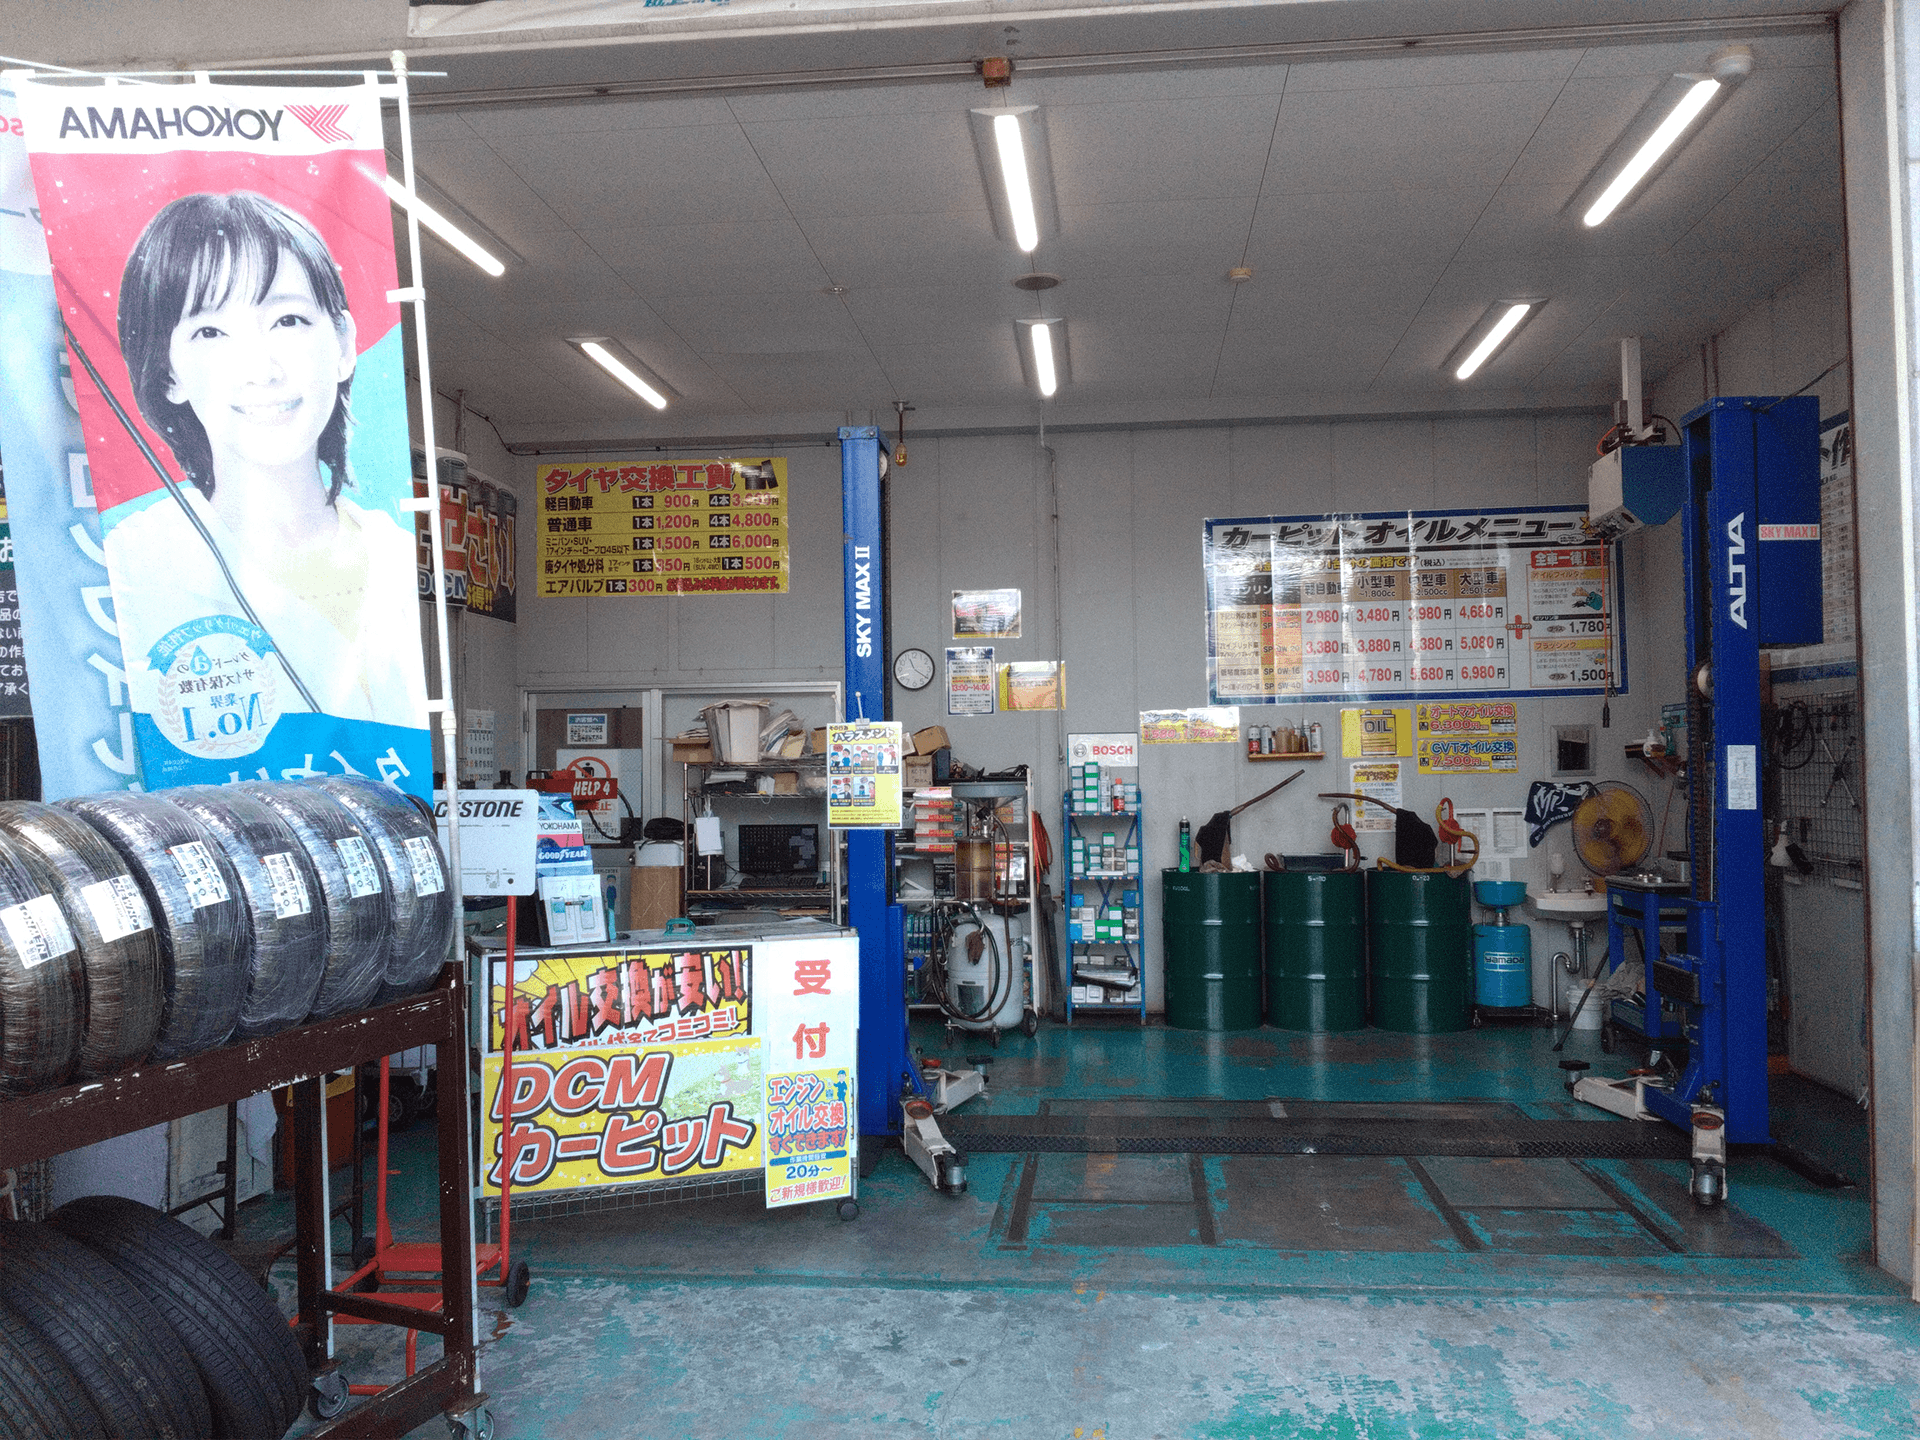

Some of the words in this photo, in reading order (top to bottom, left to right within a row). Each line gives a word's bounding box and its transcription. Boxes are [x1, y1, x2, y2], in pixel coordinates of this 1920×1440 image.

[545, 496, 593, 511] 軽自動車
[634, 497, 653, 508] 1本
[664, 494, 699, 508] 900円
[710, 495, 729, 506] 4本
[548, 517, 592, 532] 普通車
[634, 517, 653, 528] 1本
[656, 515, 699, 529] 1,200円
[710, 515, 729, 526] 4本
[732, 513, 779, 527] 4,800円
[1222, 523, 1356, 549] カーピット
[1363, 517, 1576, 545] オイルメニュー
[1761, 526, 1783, 538] SKY
[1784, 526, 1809, 538] MAX
[634, 538, 653, 549] 1本
[656, 536, 699, 550] 1,500円
[710, 535, 729, 546] 4本
[732, 534, 779, 548] 6,000円
[634, 559, 653, 571] 1本
[722, 557, 742, 569] 1本
[745, 556, 780, 569] 500円
[1728, 512, 1748, 630] ALTIA
[545, 579, 604, 594] エアバルブ
[607, 580, 626, 592] 1本
[629, 579, 663, 593] 300円
[855, 563, 870, 609] MAX
[1358, 575, 1396, 588] 小型車
[1459, 571, 1499, 586] 大型車
[1306, 609, 1348, 623] 2,980円
[1356, 608, 1400, 622] 3,480円
[1459, 605, 1503, 619] 4,680円
[857, 614, 871, 657] SKY
[1306, 640, 1348, 654] 3,380円
[1357, 639, 1401, 653] 3,880円
[1461, 636, 1504, 650] 5,080円
[1264, 667, 1274, 675] SP
[1306, 670, 1349, 684] 3,980円
[1358, 668, 1401, 682] 4,780円
[1410, 667, 1453, 681] 5,680円
[1461, 665, 1505, 680] 6,980円
[1264, 682, 1274, 690] SP
[1431, 704, 1515, 718] オートマオイル交換
[1364, 719, 1393, 733] OIL
[834, 729, 894, 742] ハラスメント
[1093, 746, 1133, 756] BOSCH
[1431, 741, 1515, 754] CVTオイル交換
[573, 781, 601, 796] HELP
[602, 781, 610, 796] 4
[433, 801, 523, 818] GSTONE
[539, 822, 581, 831] YOKOHAMA
[538, 849, 588, 861] GOODYEAR
[493, 1053, 669, 1120] DCM
[770, 1075, 823, 1104] エンジン
[770, 1101, 847, 1135] オイル交換
[492, 1104, 753, 1184] カーピット
